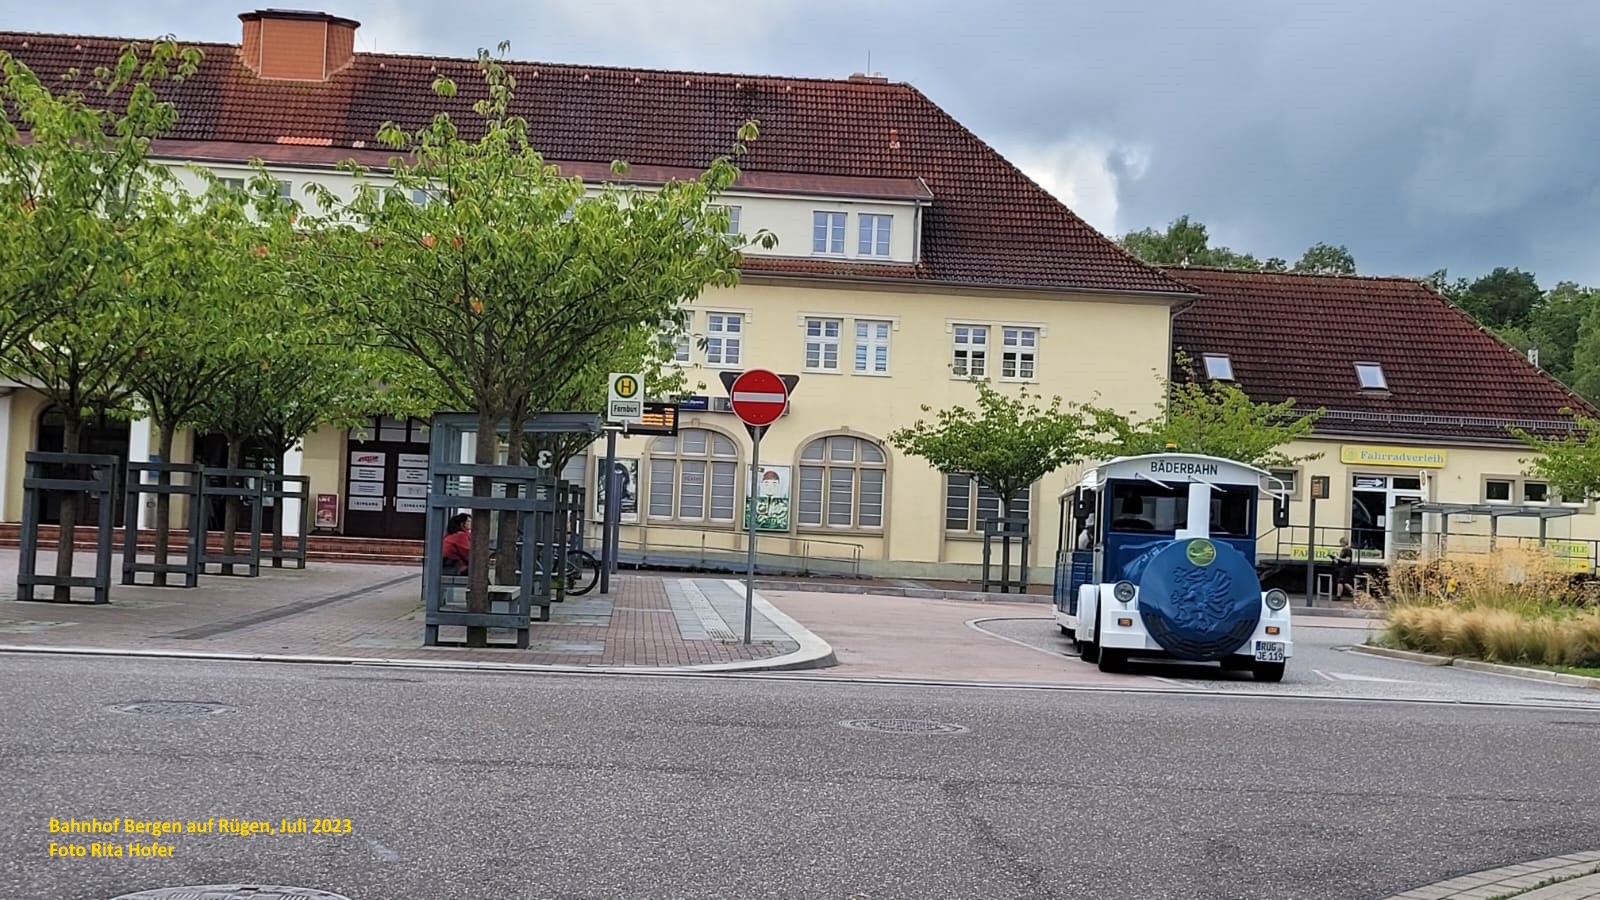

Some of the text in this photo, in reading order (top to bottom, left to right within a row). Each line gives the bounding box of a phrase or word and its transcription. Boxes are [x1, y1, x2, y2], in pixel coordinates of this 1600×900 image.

[621, 380, 632, 394] H
[613, 404, 638, 413] Fernbus
[1360, 450, 1444, 463] Fahrradverleih
[1150, 459, 1218, 475] BÄDERBAHN
[1261, 642, 1277, 651] RUG
[1257, 651, 1283, 661] JE 119
